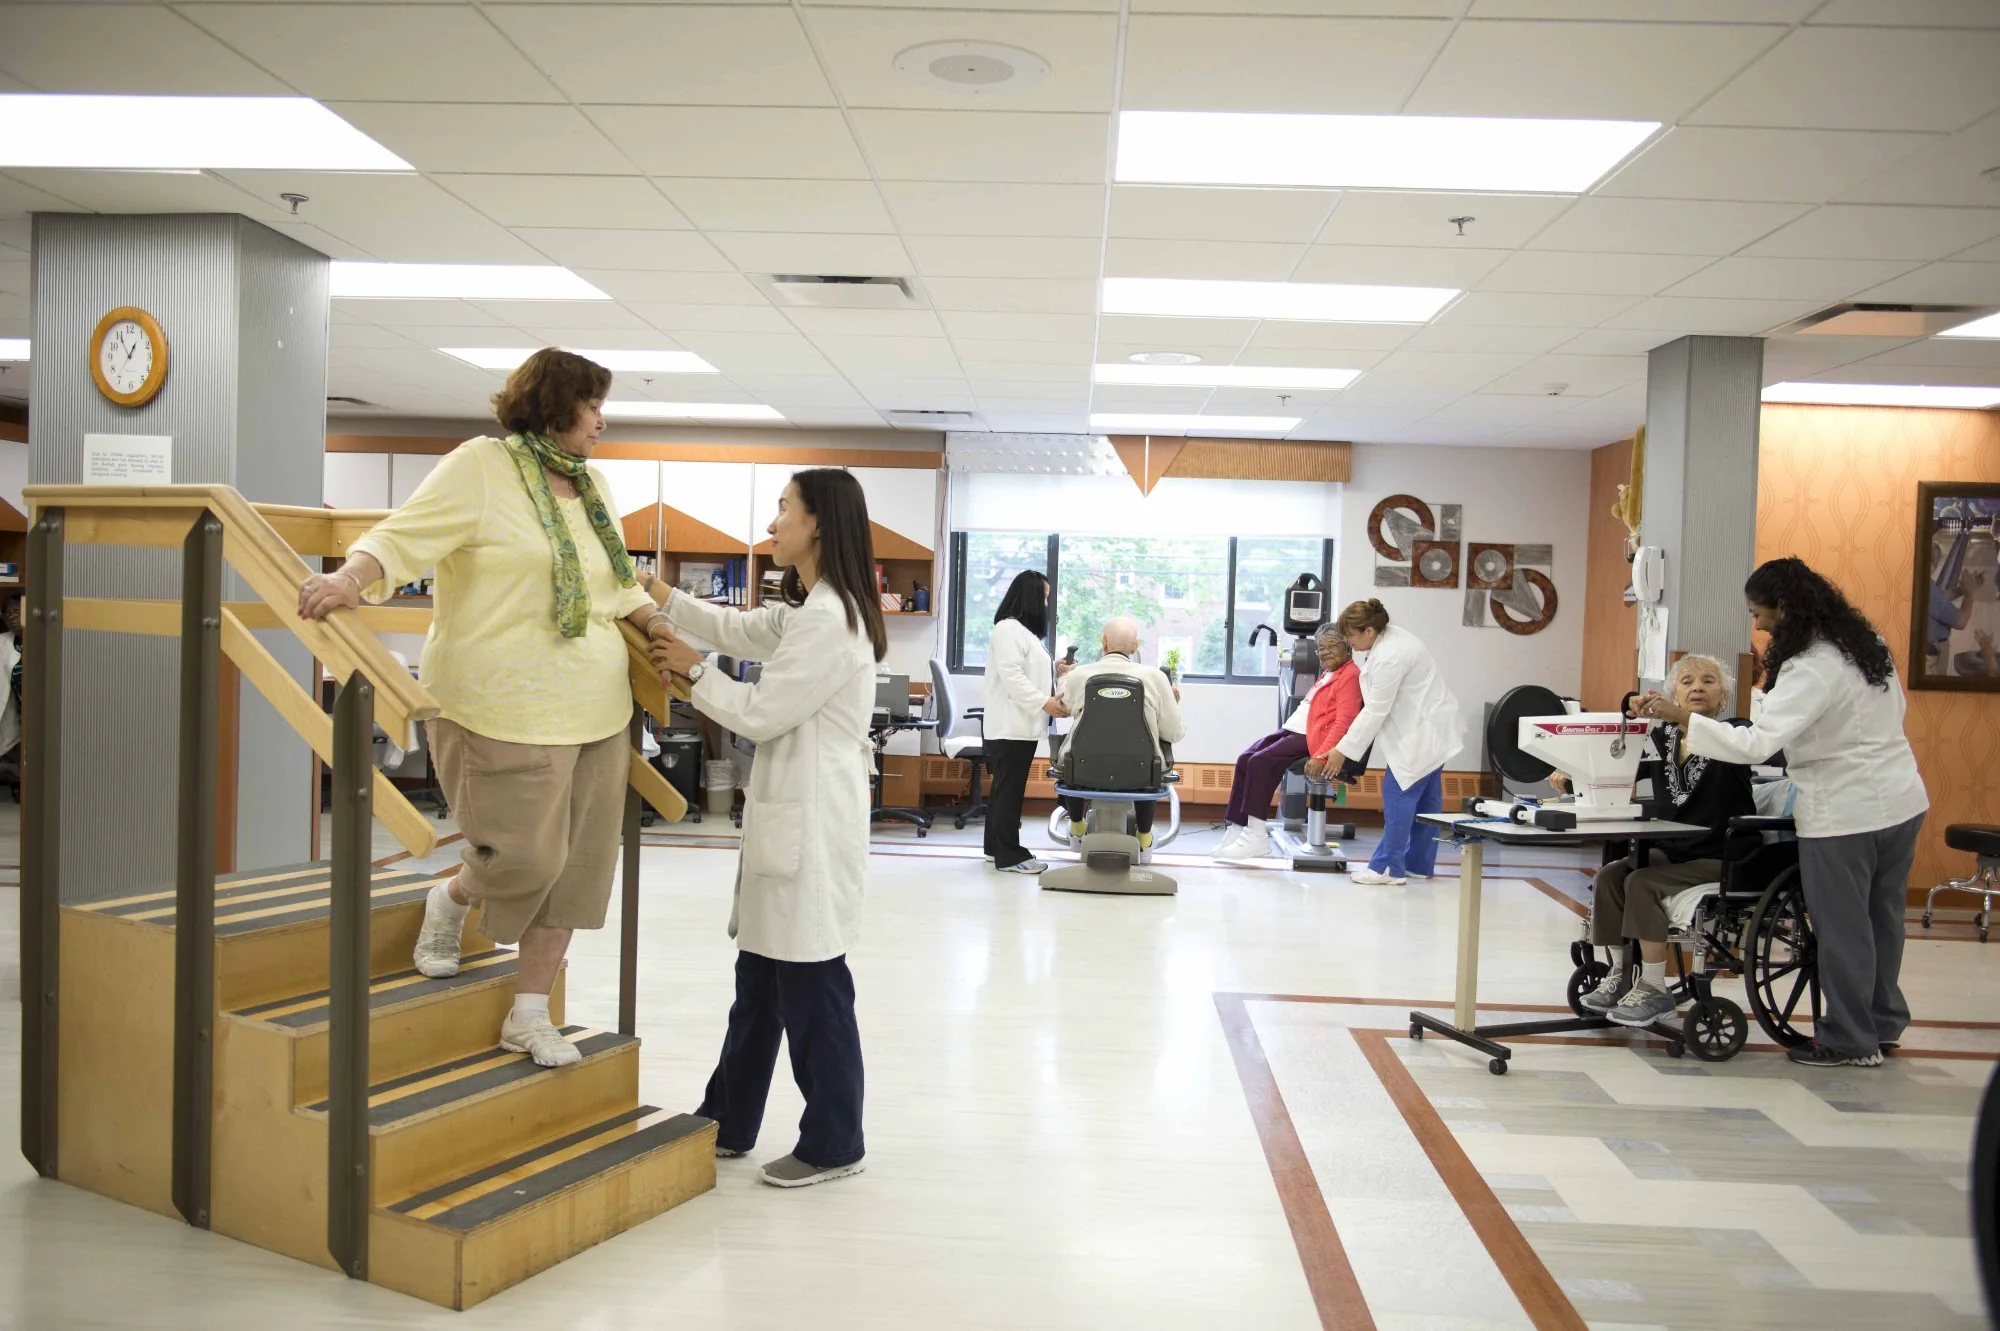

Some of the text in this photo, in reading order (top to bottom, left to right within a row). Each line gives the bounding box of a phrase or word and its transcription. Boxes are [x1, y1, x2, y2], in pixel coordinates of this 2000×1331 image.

[126, 325, 134, 334] 12
[111, 342, 118, 351] 10
[145, 341, 150, 350] 2
[108, 353, 113, 362] 9
[147, 352, 152, 361] 3
[111, 365, 116, 374] 8
[118, 376, 122, 384] 7
[140, 375, 144, 384] 5
[128, 381, 134, 390] 6
